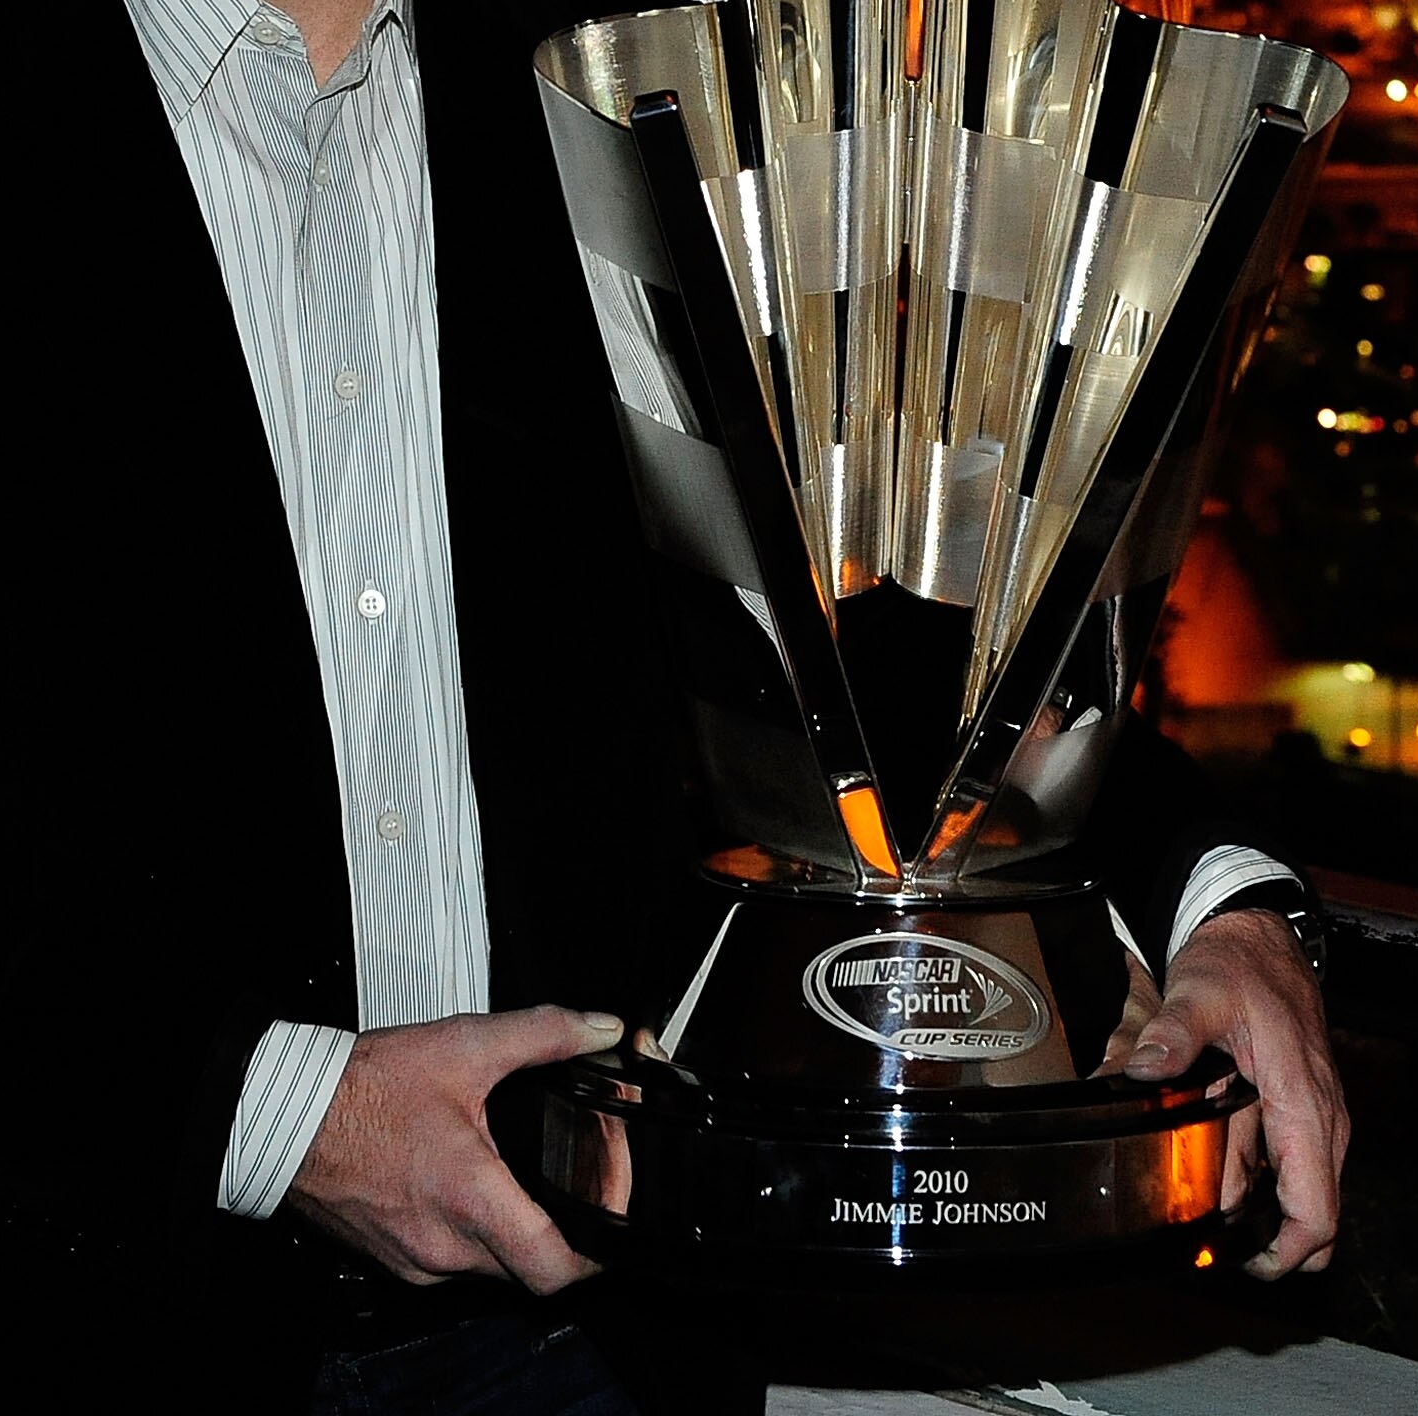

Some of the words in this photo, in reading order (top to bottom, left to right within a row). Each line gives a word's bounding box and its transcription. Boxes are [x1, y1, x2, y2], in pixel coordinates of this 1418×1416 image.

[871, 959, 956, 984] NASCAR
[886, 986, 971, 1019] Sprint
[899, 1033, 947, 1046] CUP
[949, 1033, 1025, 1049] SERIES
[913, 1170, 969, 1194] 2010
[831, 1198, 923, 1225] JIMMIE
[932, 1199, 1047, 1225] JOHNSON
